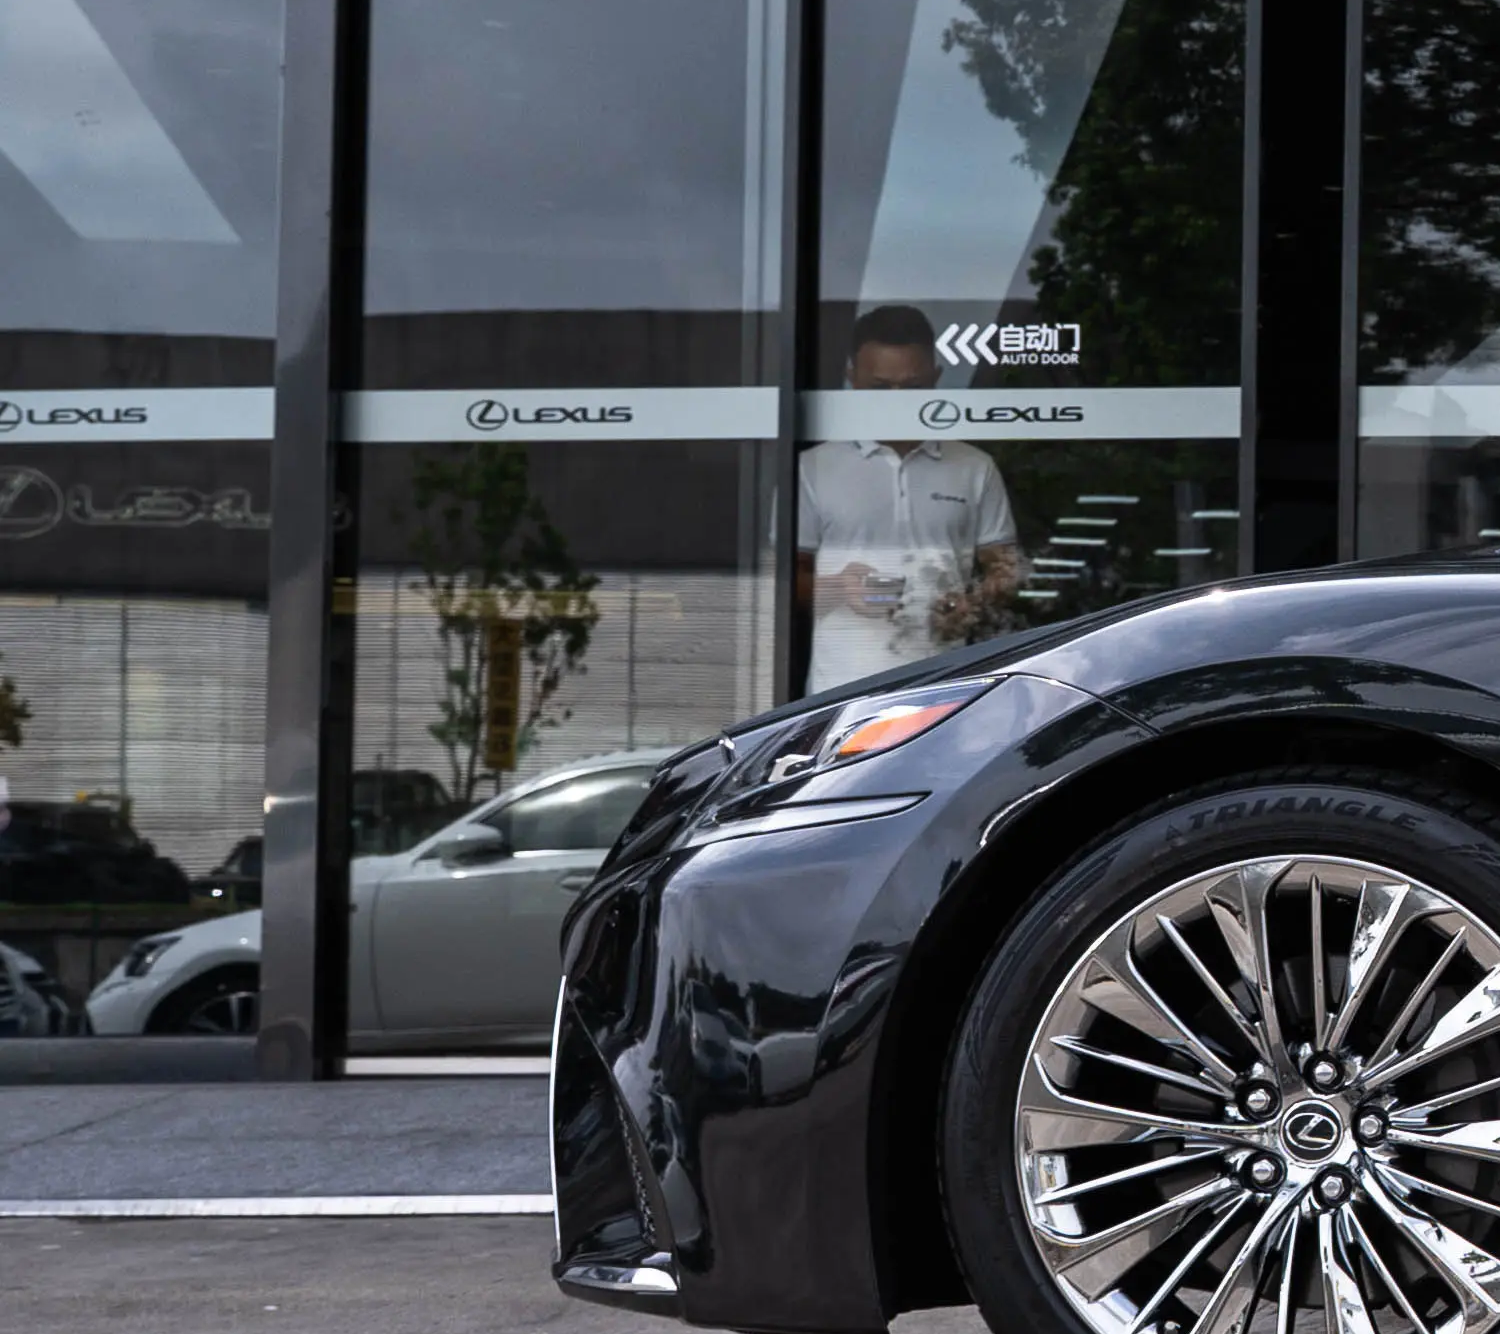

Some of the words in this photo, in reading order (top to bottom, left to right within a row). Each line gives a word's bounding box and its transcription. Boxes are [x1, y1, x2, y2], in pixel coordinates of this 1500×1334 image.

[999, 322, 1081, 352] 自动门
[1000, 353, 1039, 364] AUTO
[1041, 353, 1080, 365] DOOR
[26, 407, 148, 425] LEXUS
[512, 406, 633, 424] LEXUS
[965, 406, 1084, 423] LEXUS
[1188, 795, 1428, 833] TRIANGLE
